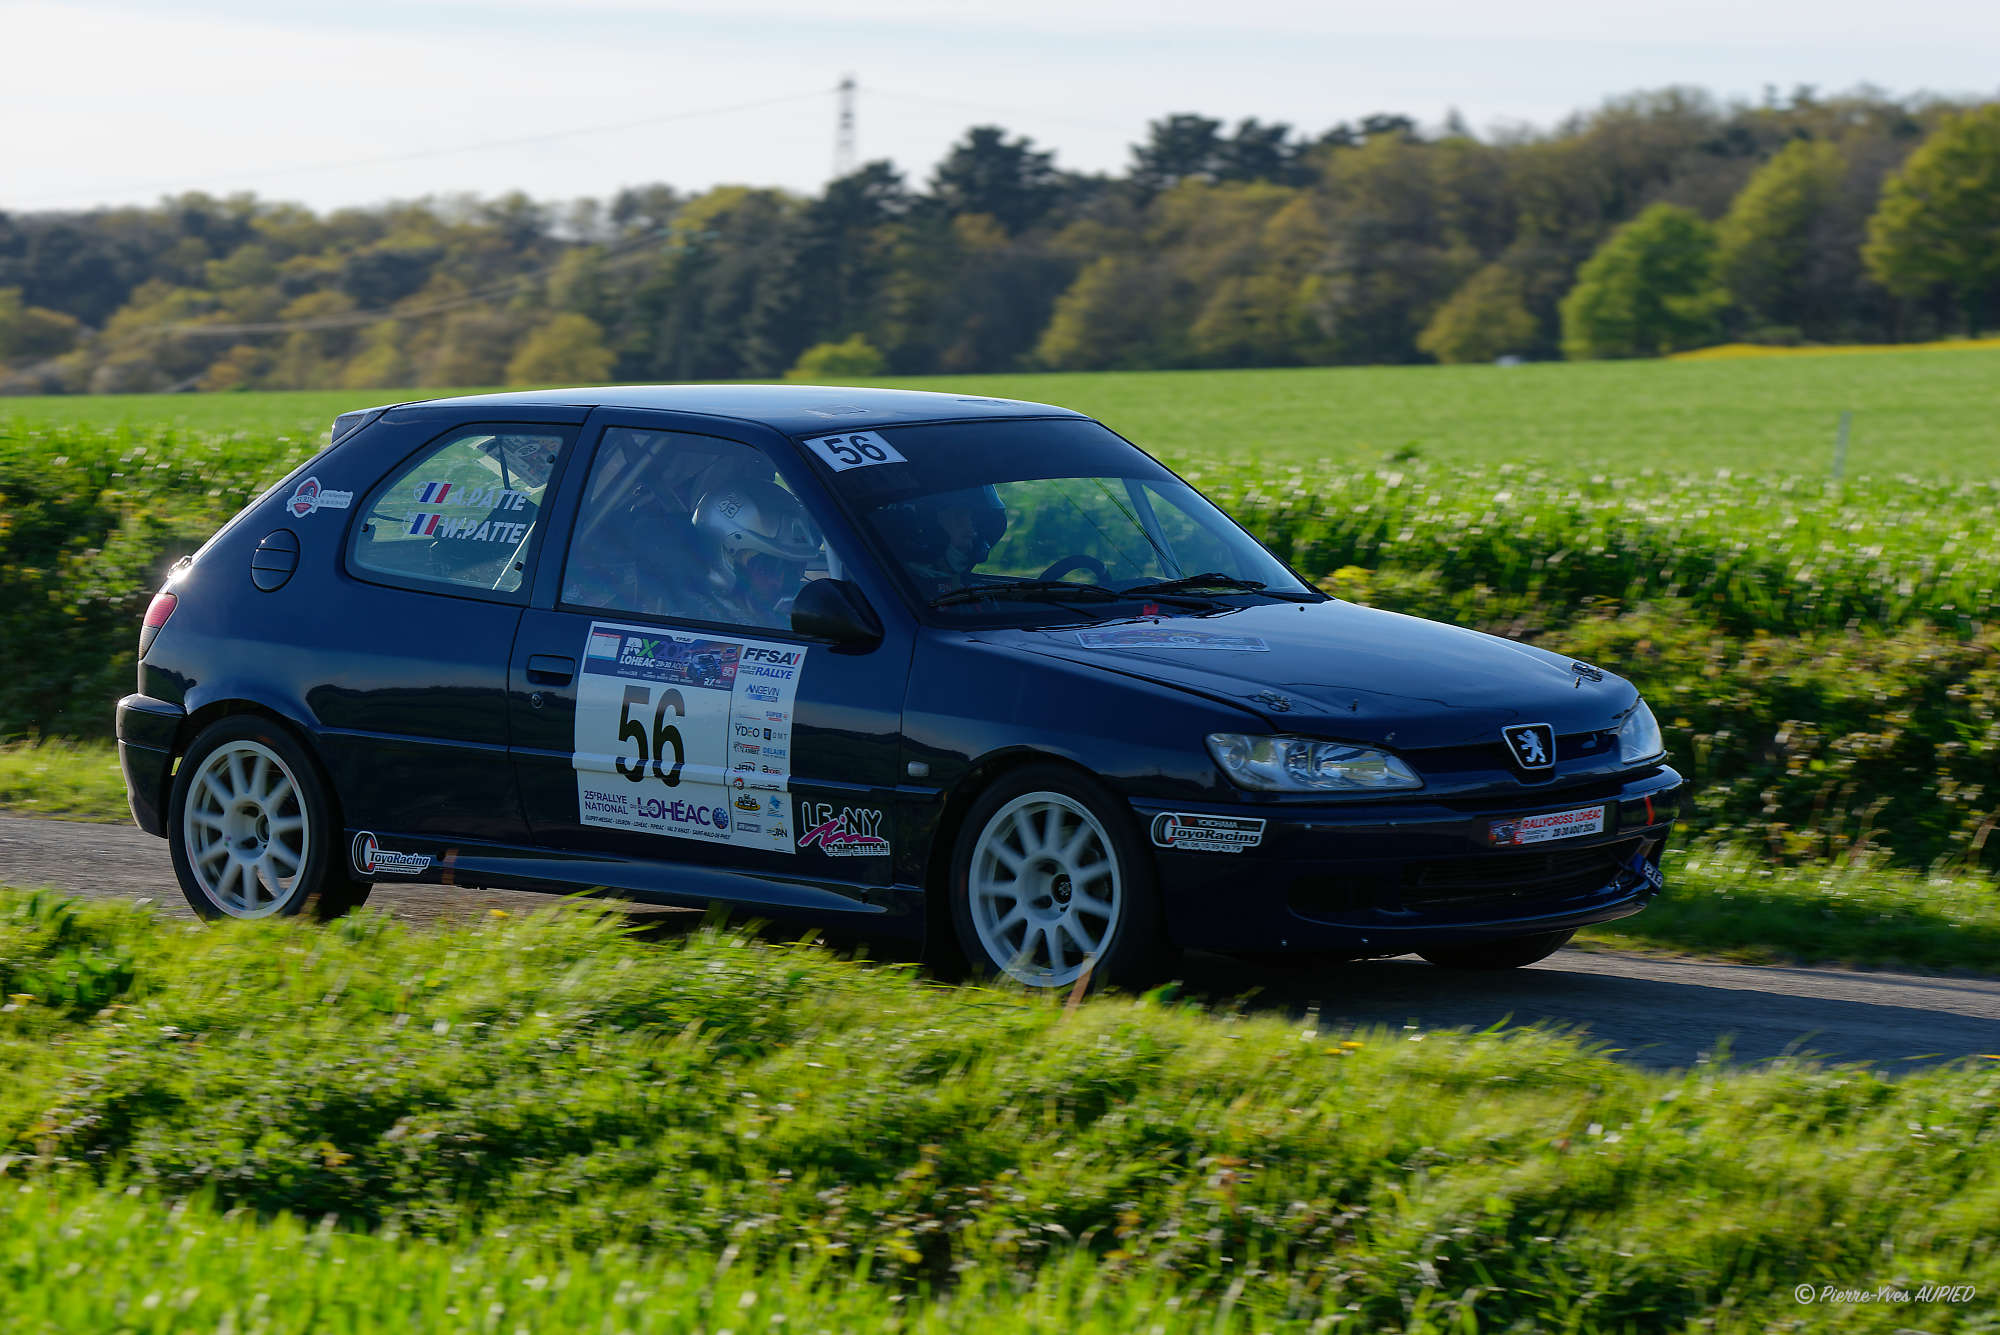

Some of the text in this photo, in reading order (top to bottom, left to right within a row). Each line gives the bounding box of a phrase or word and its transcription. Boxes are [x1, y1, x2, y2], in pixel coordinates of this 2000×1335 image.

[823, 435, 887, 465] 56
[441, 517, 528, 544] W.PATTE
[619, 654, 656, 668] LOHEAC
[743, 647, 792, 665] FFSA
[755, 667, 793, 679] RALLYE
[745, 684, 780, 696] ANGEVIN
[615, 684, 686, 788] 56
[596, 792, 628, 804] RALLYE
[584, 801, 629, 815] NATIONAL
[637, 797, 711, 826] LOHÉAC
[1522, 809, 1602, 829] RALLYCROSS LOHEAC
[1170, 826, 1260, 843] ToyoRacing
[826, 841, 890, 856] COMPETITION
[370, 851, 430, 867] ToyoRacing
